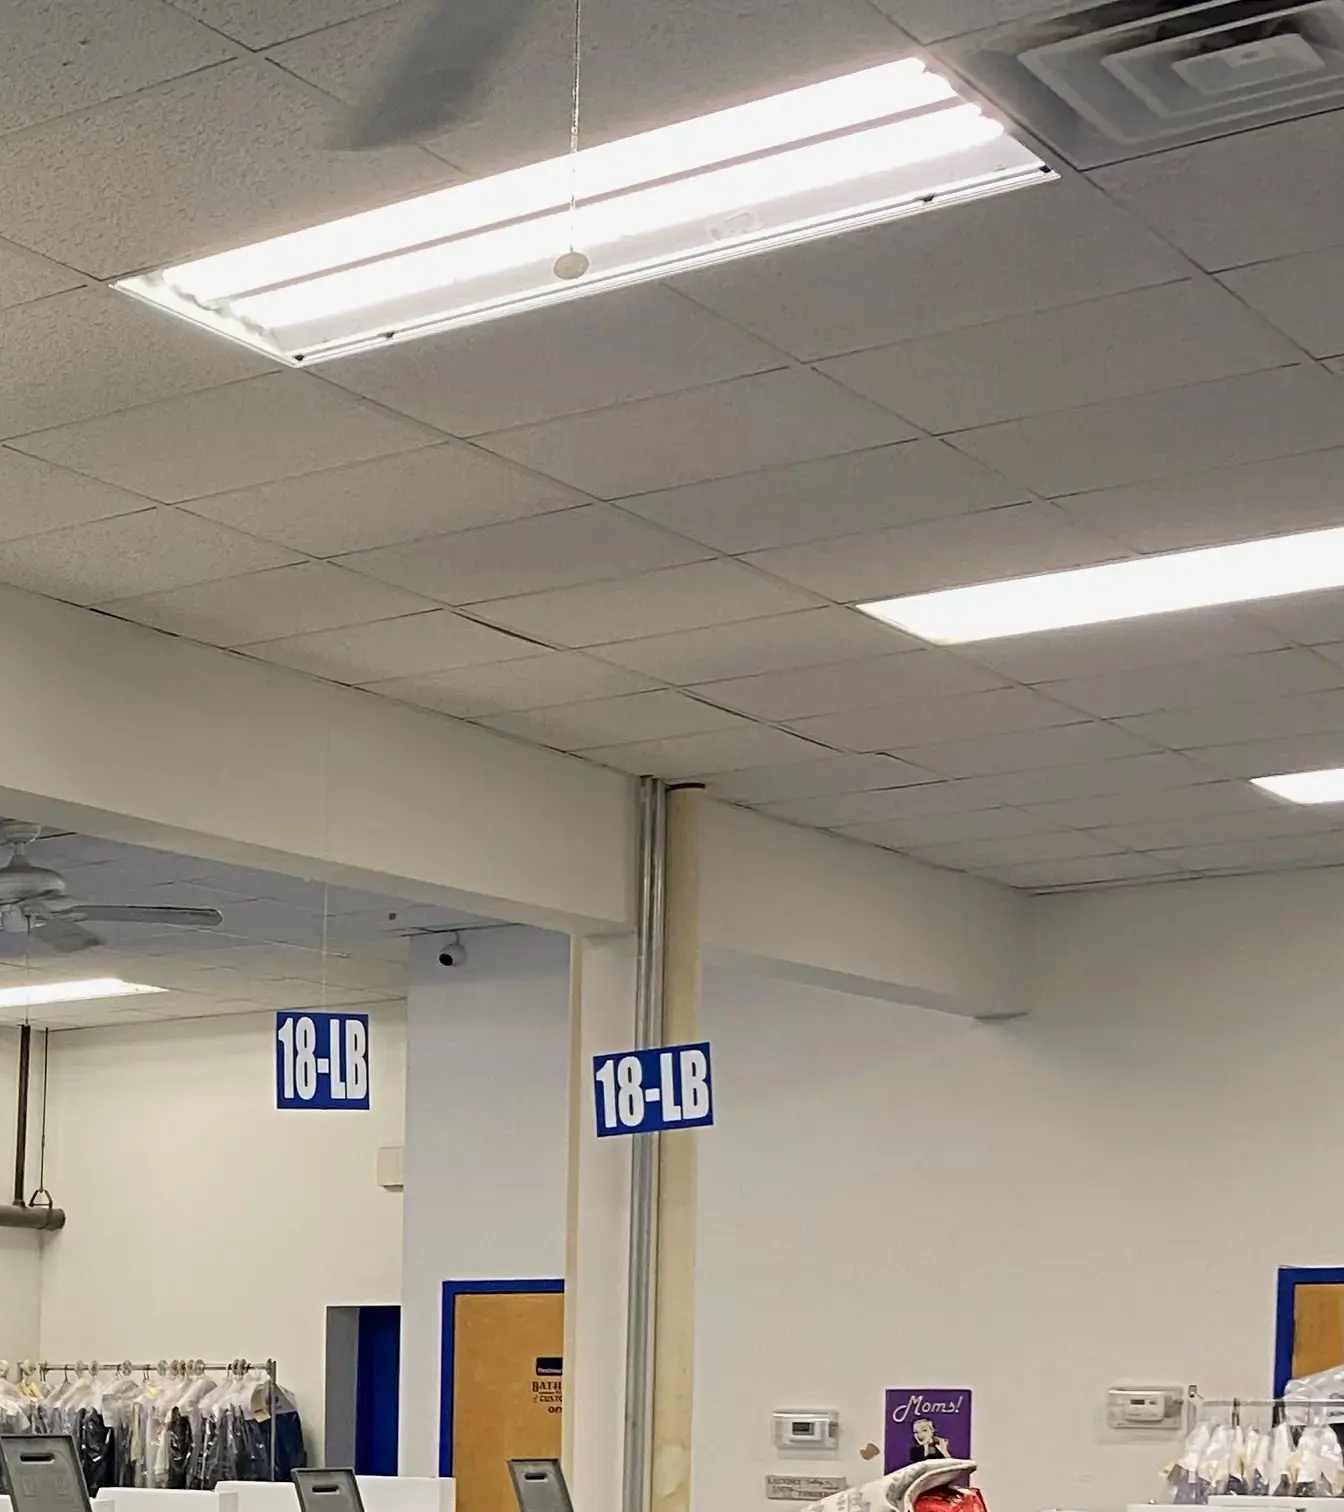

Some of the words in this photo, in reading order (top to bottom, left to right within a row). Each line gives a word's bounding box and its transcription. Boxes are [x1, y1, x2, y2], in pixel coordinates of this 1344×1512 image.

[278, 1016, 368, 1100] 18-LB
[596, 1049, 710, 1128] 18-LB
[892, 1395, 963, 1422] Moms!
